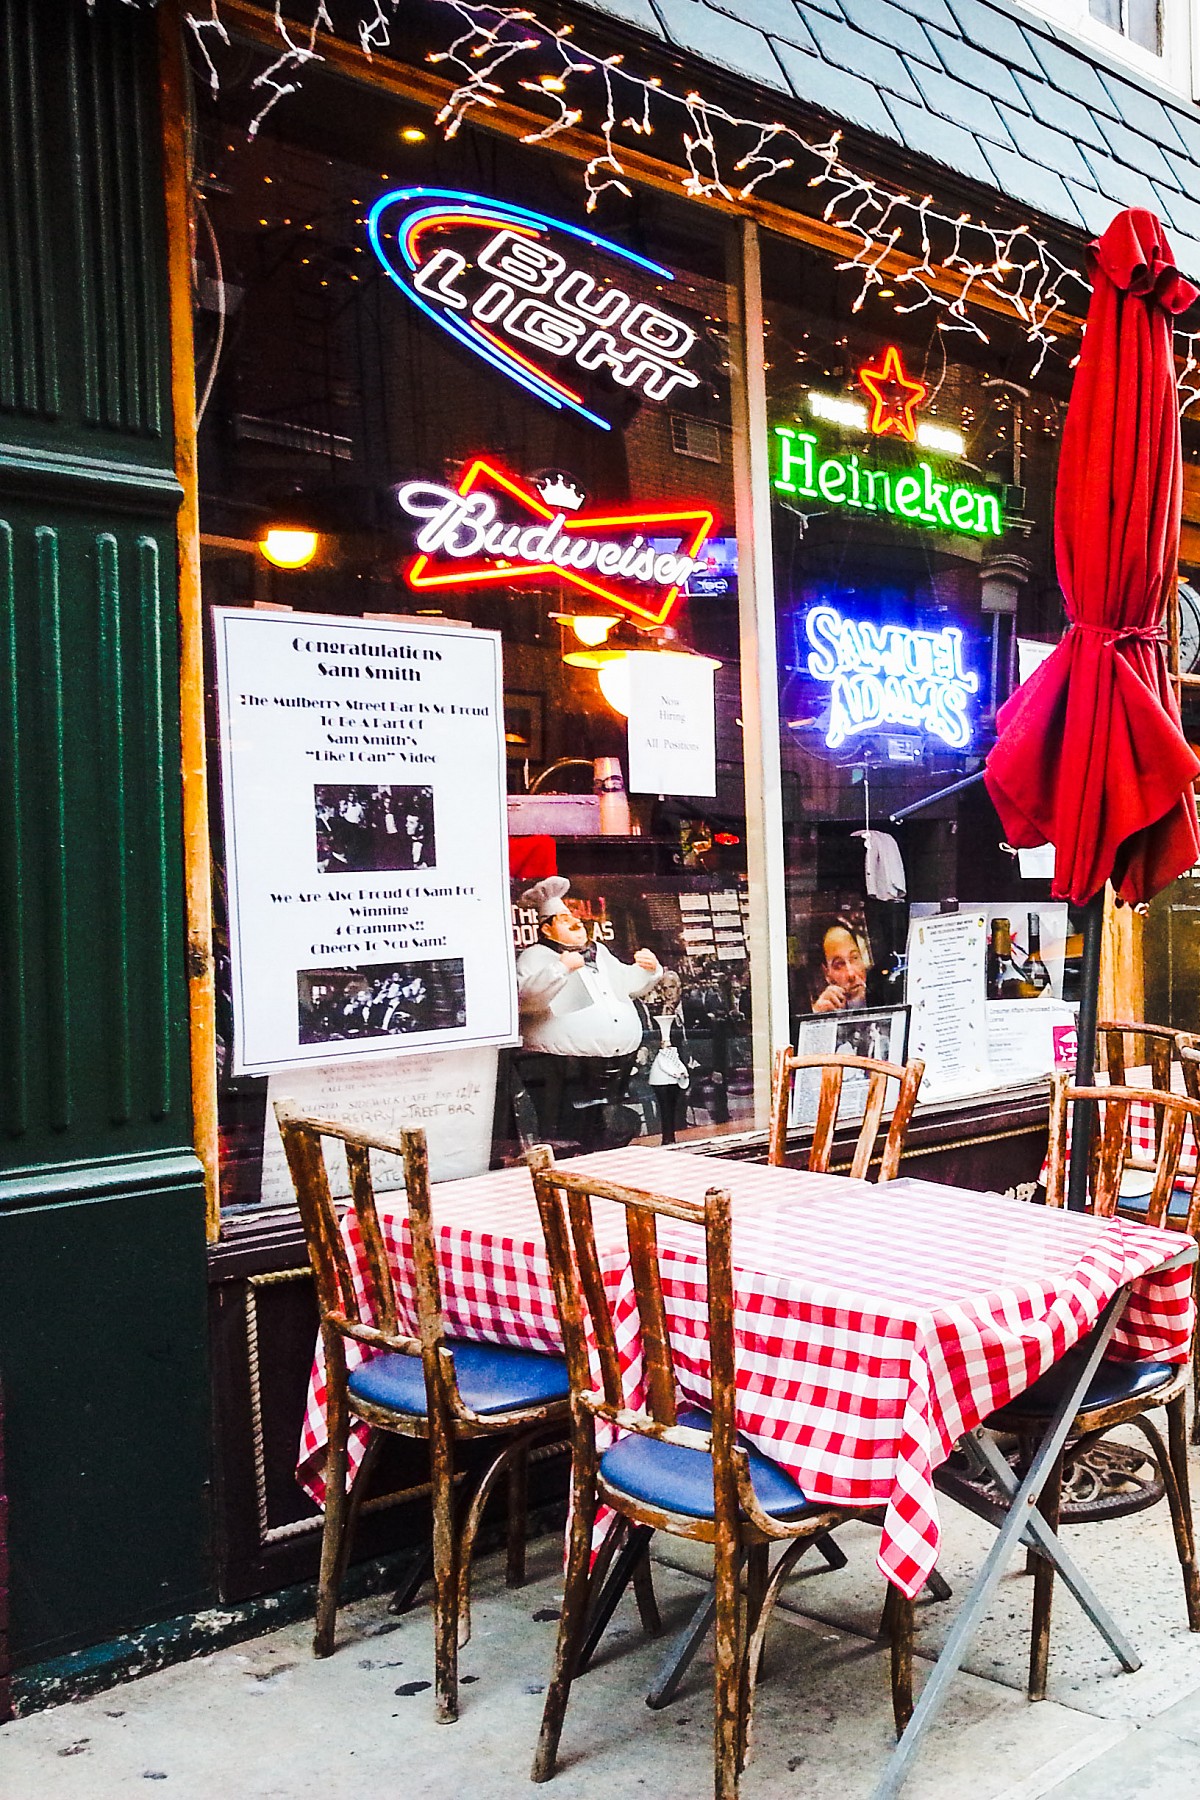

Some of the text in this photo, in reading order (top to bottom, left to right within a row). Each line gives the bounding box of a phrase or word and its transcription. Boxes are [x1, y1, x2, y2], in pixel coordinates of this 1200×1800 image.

[477, 229, 695, 359] BUD
[413, 249, 702, 401] LIGHT
[774, 426, 1003, 536] Heineken
[398, 481, 709, 587] Budweiser
[292, 637, 442, 660] Congratulations
[805, 606, 979, 694] SAMUEL
[318, 662, 421, 681] Sam Smith
[240, 694, 489, 716] The Mulberry Street Bar Is So Proud
[825, 671, 970, 748] ADAMS
[320, 716, 424, 730] To Be A Part Of
[327, 734, 418, 746] Sam Smith's
[350, 752, 354, 761] I
[400, 753, 438, 764] Video
[270, 886, 476, 903] We Are Also Proud Of Sam For
[349, 905, 409, 917] Winning
[336, 921, 424, 935] 4 Grammys!!
[310, 936, 447, 954] Cheers To You Sam!
